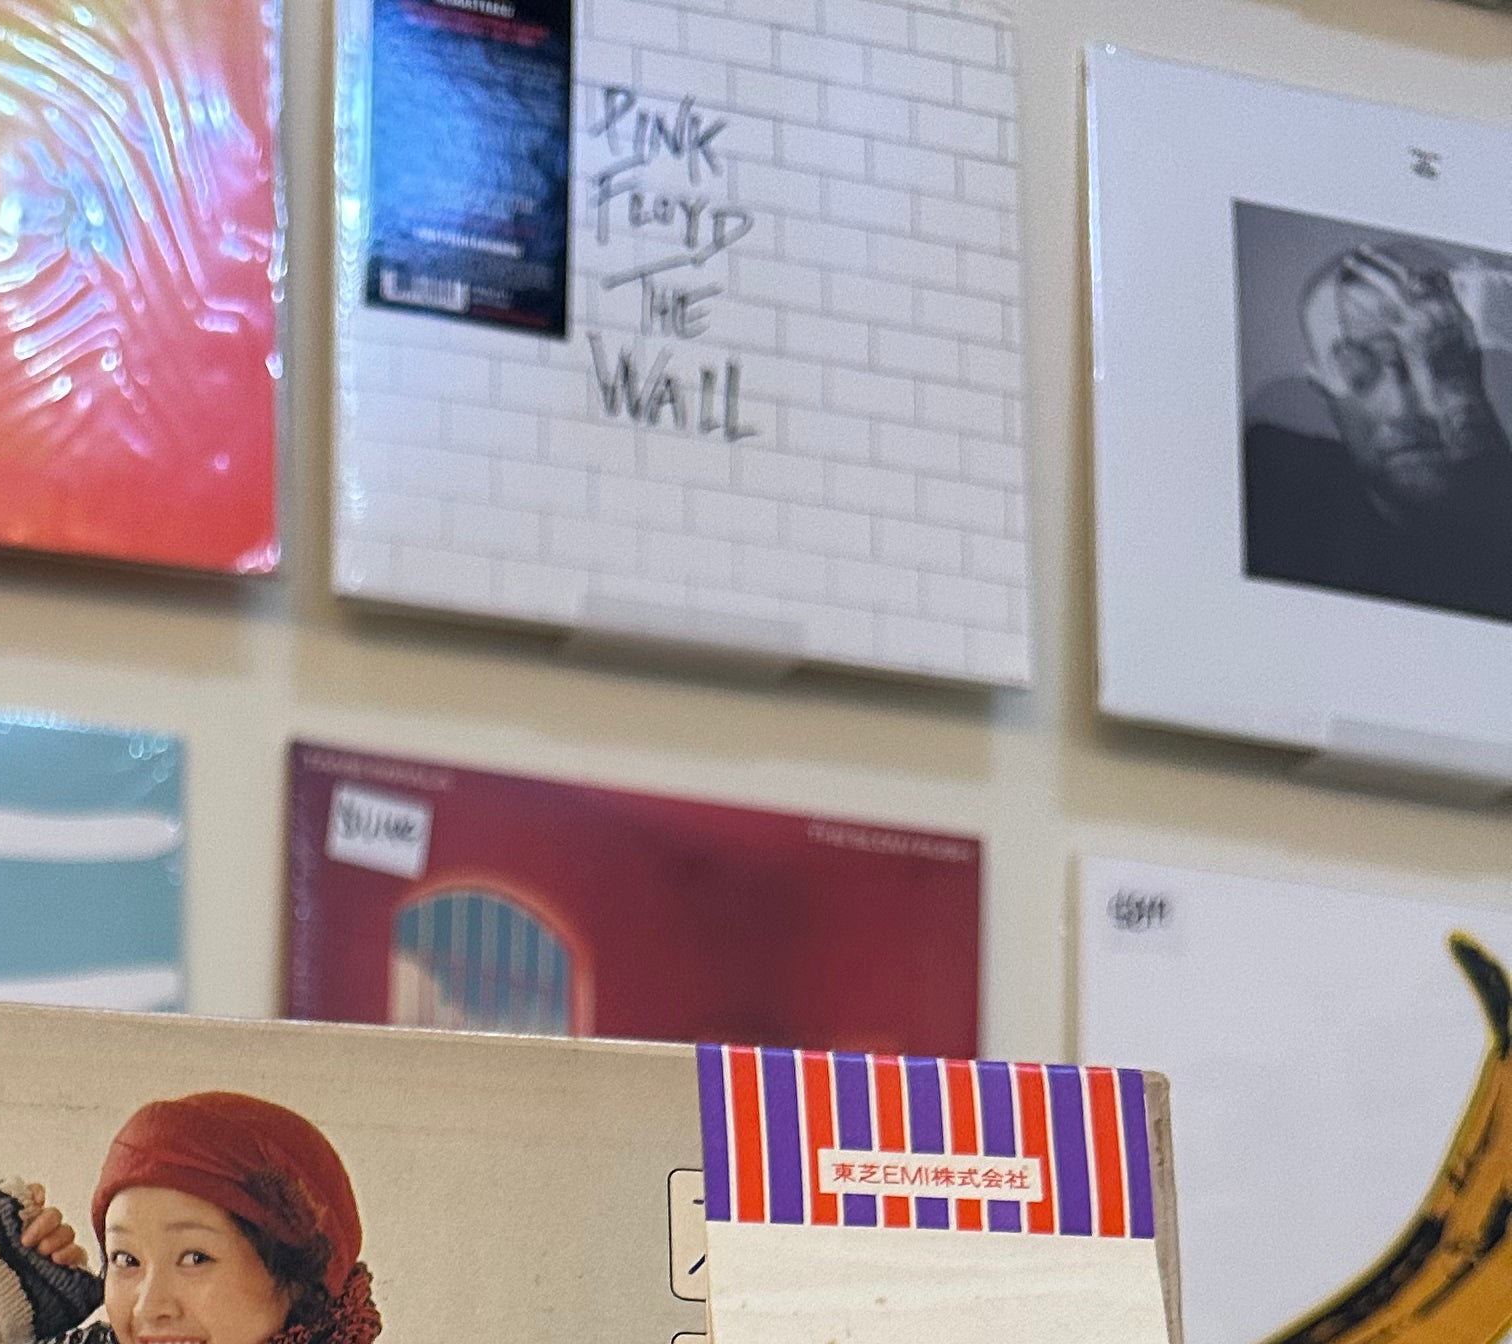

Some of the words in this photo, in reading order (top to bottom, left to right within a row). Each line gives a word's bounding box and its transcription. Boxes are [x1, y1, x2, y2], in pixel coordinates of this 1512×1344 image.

[589, 85, 728, 187] PINK
[591, 154, 755, 262] FLOYD
[600, 255, 725, 340] THE
[586, 330, 760, 442] WALL
[832, 1161, 1031, 1190] 東芝EMI株式会社
